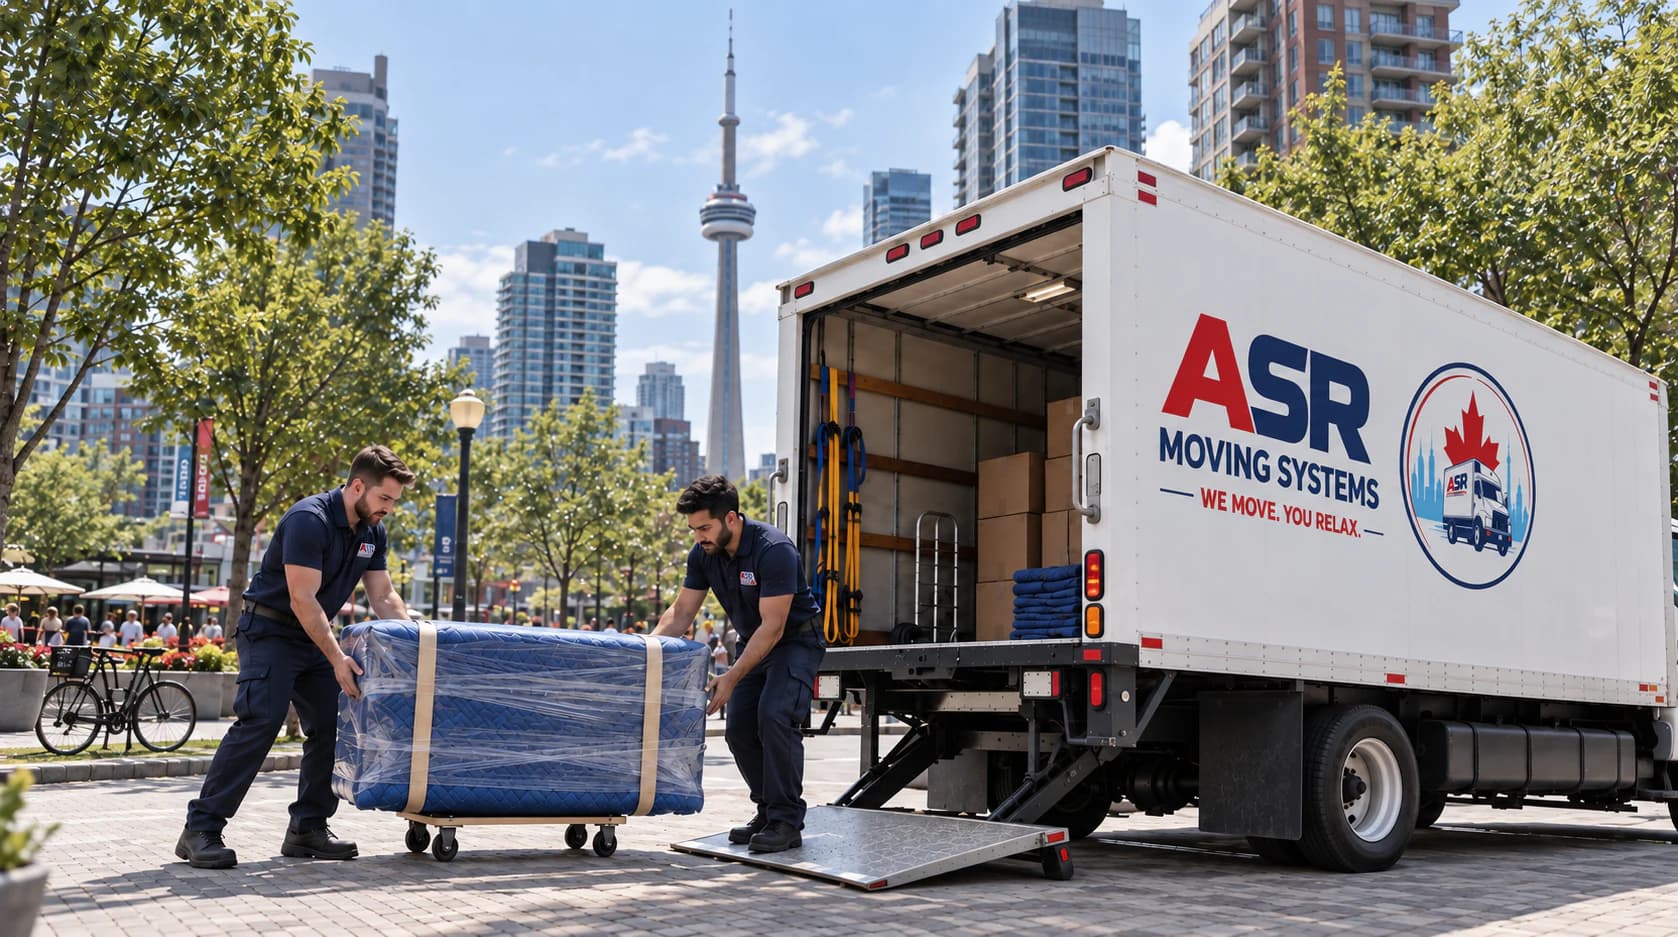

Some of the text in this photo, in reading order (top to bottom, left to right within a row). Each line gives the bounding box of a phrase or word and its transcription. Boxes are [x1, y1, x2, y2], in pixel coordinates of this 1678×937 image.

[1161, 313, 1372, 465] ASR
[1160, 426, 1380, 510] MOVING SYSTEMS
[1446, 472, 1468, 492] ASR
[1200, 487, 1362, 539] WE MOVE. YOU RELAX.
